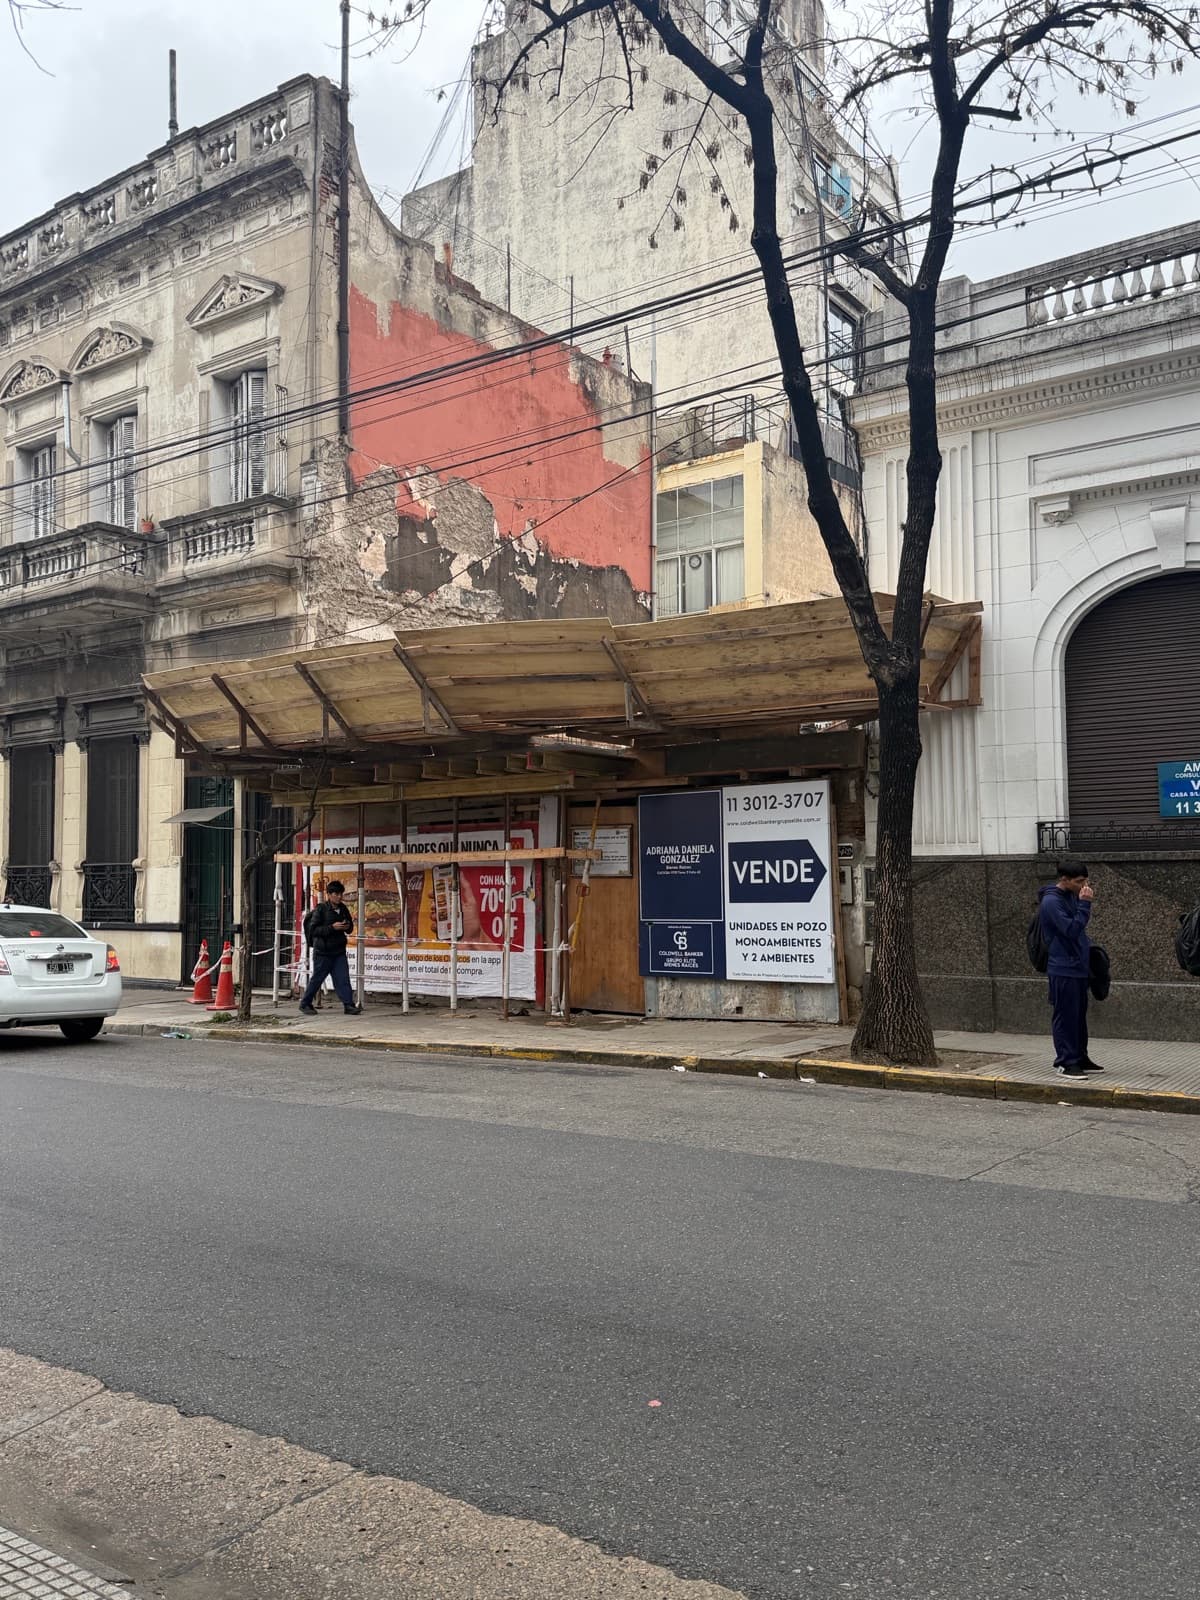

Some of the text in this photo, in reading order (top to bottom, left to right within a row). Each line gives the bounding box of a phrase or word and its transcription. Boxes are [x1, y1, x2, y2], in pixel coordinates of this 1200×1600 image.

[727, 792, 824, 812] 11 3012-3707
[1176, 802, 1189, 814] 11
[646, 844, 715, 856] ADRIANA DANIELA
[660, 854, 701, 864] GONZALEZ
[732, 858, 815, 884] VENDE
[479, 875, 493, 885] CON
[492, 916, 518, 938] OF
[729, 922, 827, 931] UNIDADES EN POZO
[735, 937, 822, 948] MONOAMBIENTES
[407, 954, 423, 963] uego
[424, 954, 432, 962] de
[488, 957, 501, 966] app
[742, 953, 815, 963] Y 2 AMBIENTES
[424, 965, 439, 973] total
[440, 966, 448, 974] de
